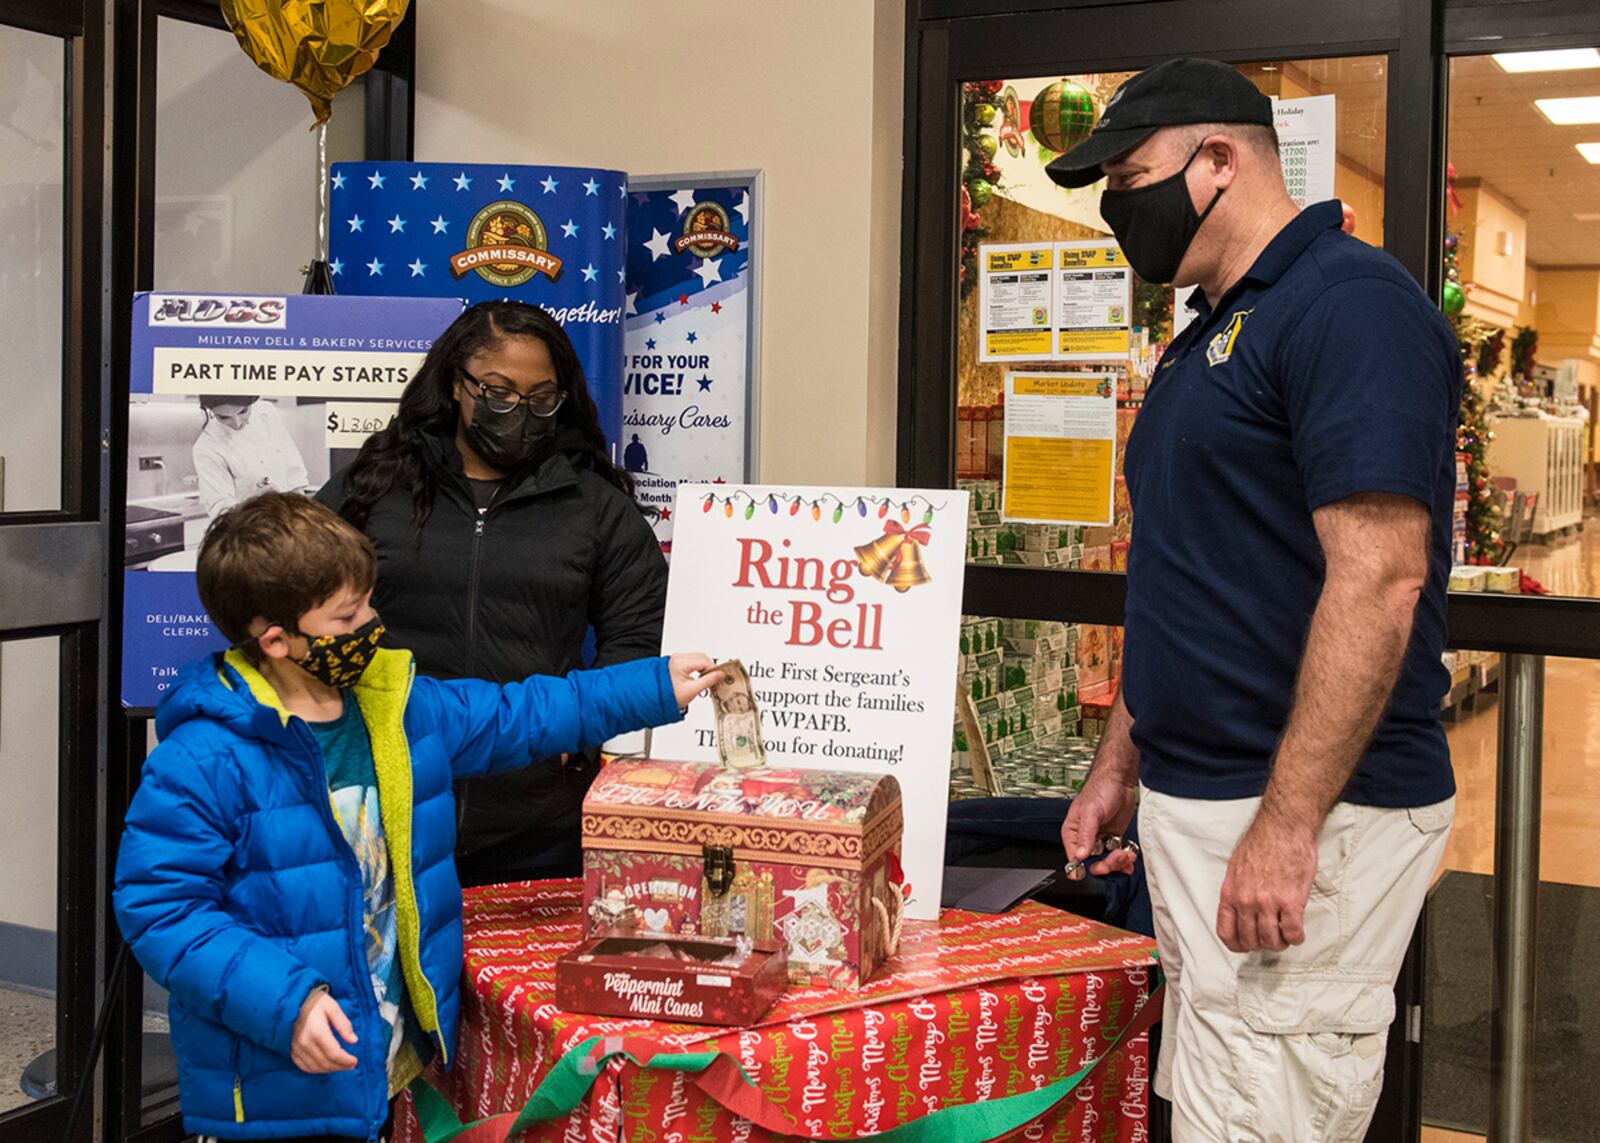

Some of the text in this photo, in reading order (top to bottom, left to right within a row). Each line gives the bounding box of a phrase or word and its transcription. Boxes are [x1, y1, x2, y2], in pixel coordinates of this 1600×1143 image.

[1277, 108, 1304, 116] Holiday
[678, 233, 735, 247] COMMISSARY
[457, 249, 556, 270] COMMISSARY
[198, 335, 433, 349] MILITARY DELI & BAKERY SERVICES
[171, 363, 408, 383] PART TIME PAY STARTS
[632, 355, 663, 369] FOR
[667, 355, 710, 369] YOUR
[679, 405, 731, 429] Cares
[640, 493, 672, 503] Month
[732, 538, 858, 604] Ring
[163, 627, 209, 637] CLERKS
[747, 600, 883, 650] the Bell
[151, 667, 178, 676] Talk
[749, 661, 911, 688] the First Sergeant's
[755, 689, 925, 713] support the families
[771, 711, 851, 732] WPAFB.
[791, 736, 817, 755] for
[822, 739, 904, 764] donating!
[604, 973, 684, 1000] Peppermint
[629, 994, 704, 1018] Mini Canes
[1080, 972, 1104, 1032] Merry
[976, 988, 998, 1051] Merry
[997, 994, 1024, 1060] Christmas
[862, 1008, 885, 1071] Merry
[885, 1012, 912, 1081] Christmas
[1027, 1004, 1052, 1069] Merry
[919, 1022, 945, 1090] Merry
[802, 1041, 828, 1113] Merry
[1120, 1054, 1149, 1119] Christmas
[827, 1067, 856, 1138] Christmas
